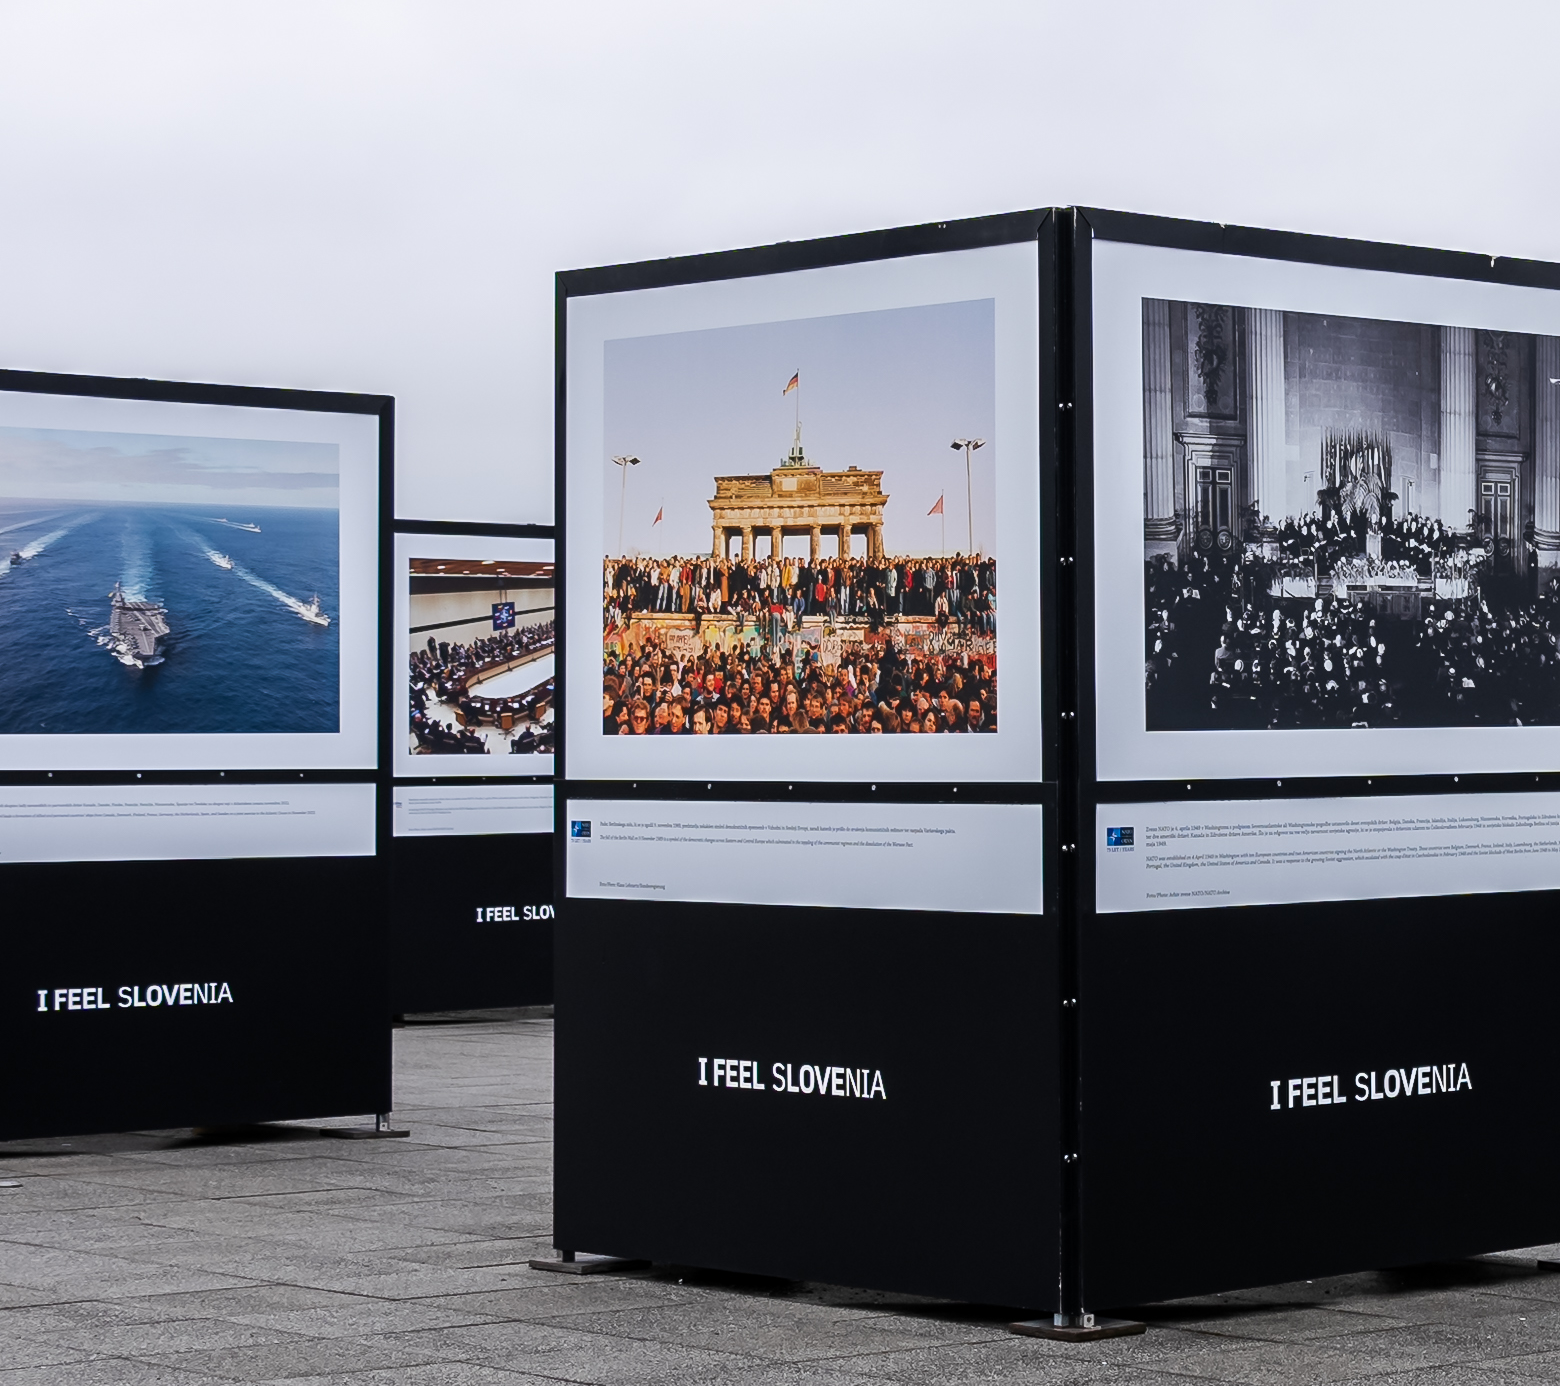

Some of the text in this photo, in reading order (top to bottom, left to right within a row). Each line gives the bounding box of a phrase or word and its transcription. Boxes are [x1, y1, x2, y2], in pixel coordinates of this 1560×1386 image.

[476, 908, 483, 922] I
[486, 906, 520, 922] FEEL
[38, 982, 234, 1012] I FEEL SLOVENIA
[698, 1058, 886, 1100] I FEEL SLOVENIA
[1270, 1062, 1472, 1110] I FEEL SLOVENIA
